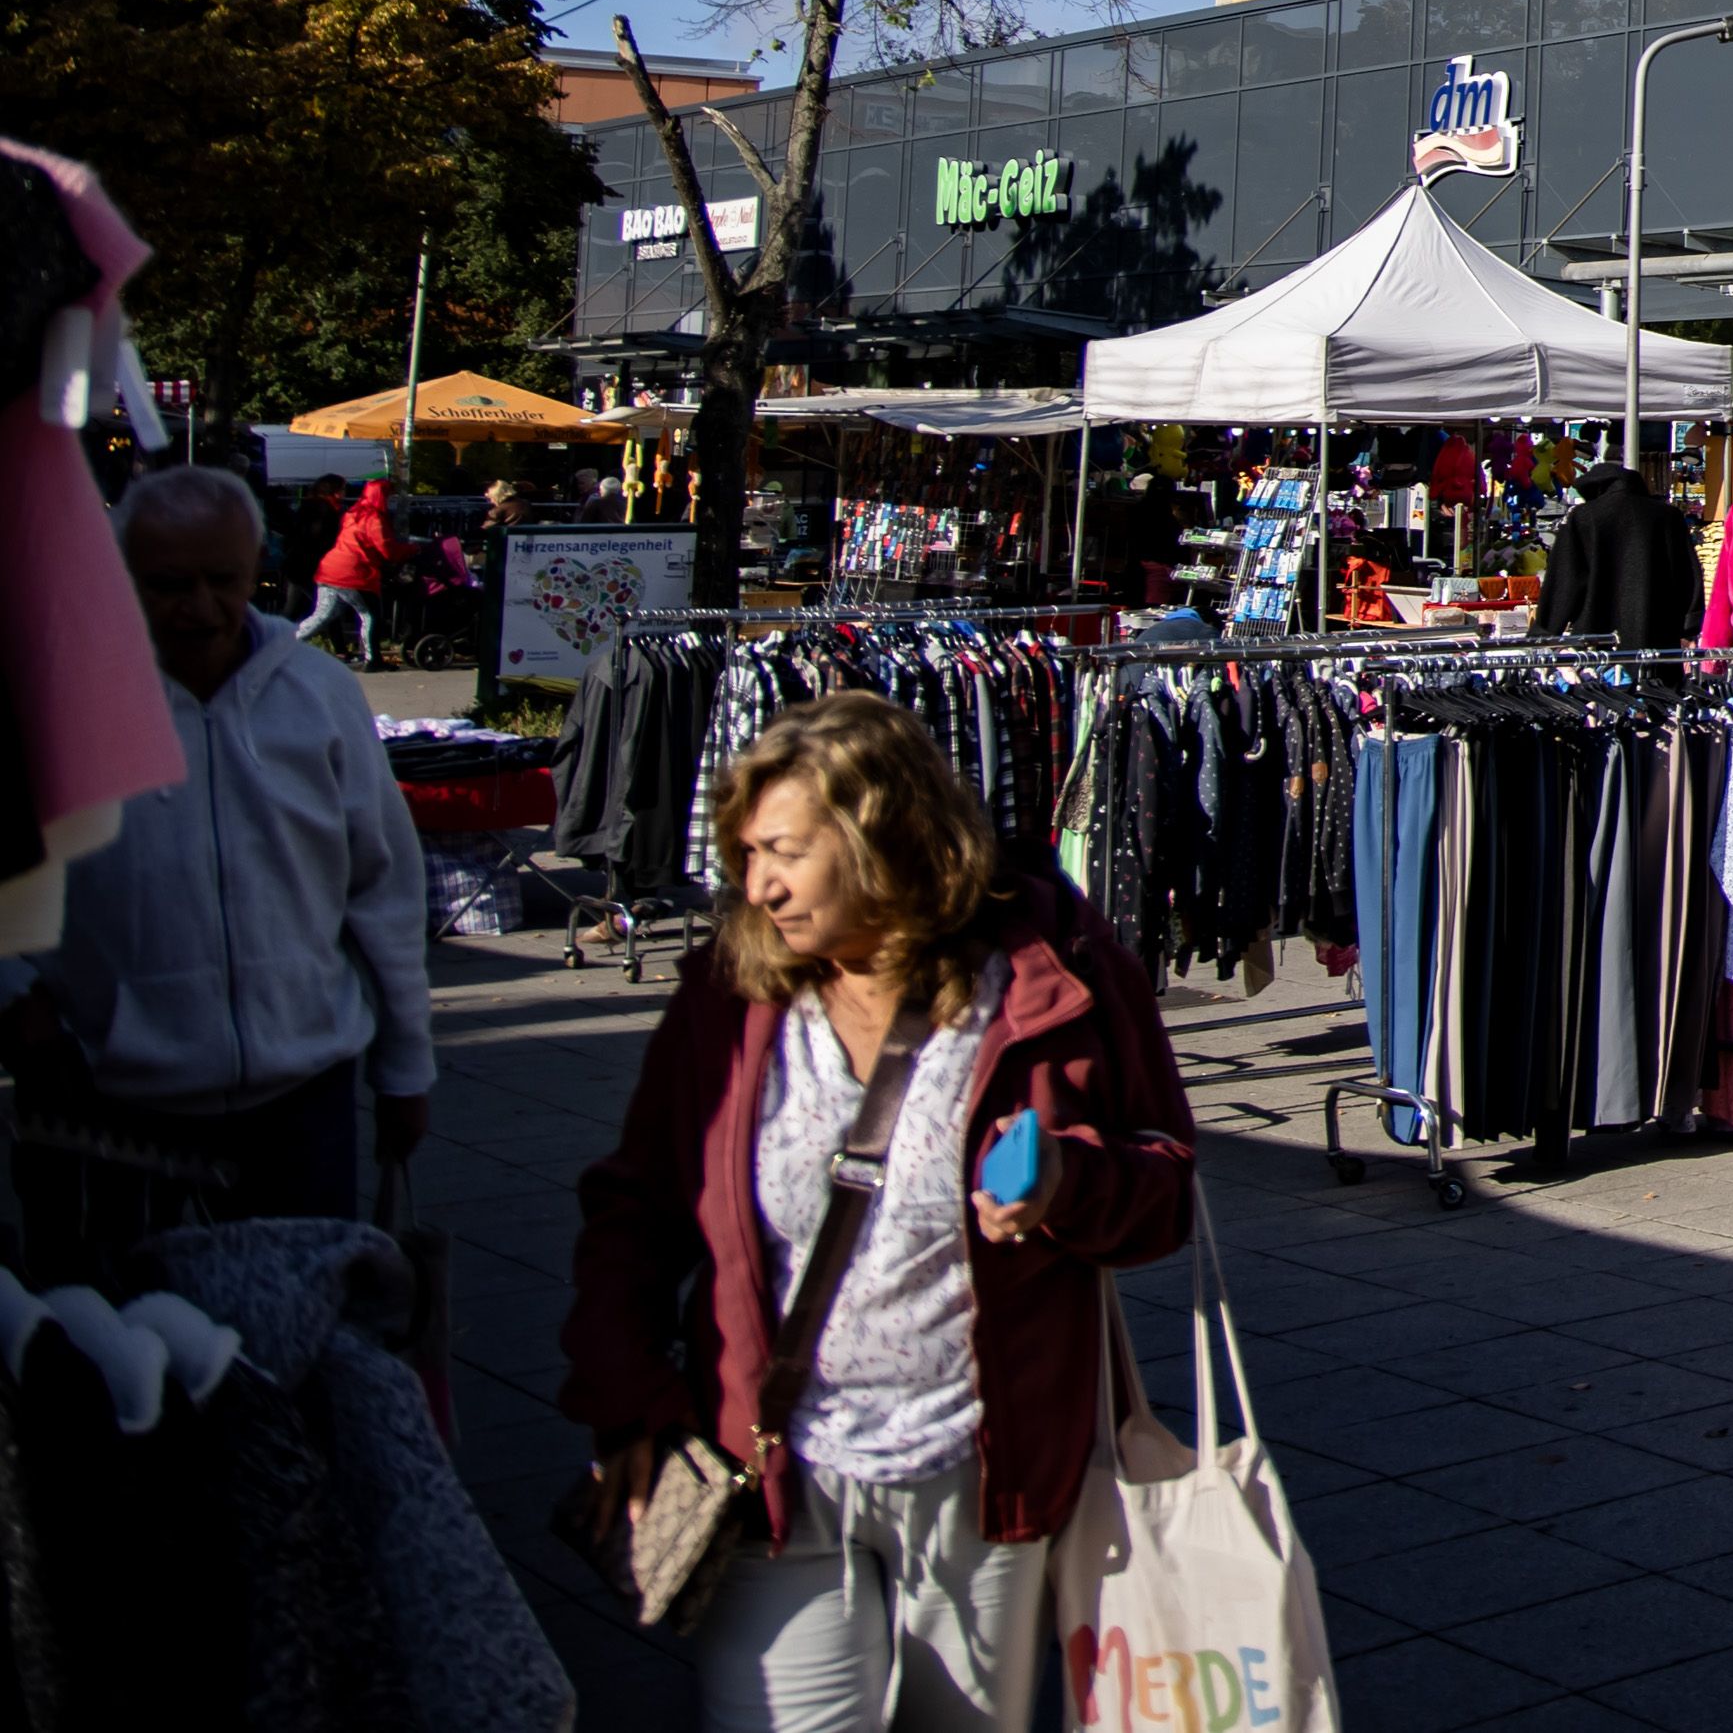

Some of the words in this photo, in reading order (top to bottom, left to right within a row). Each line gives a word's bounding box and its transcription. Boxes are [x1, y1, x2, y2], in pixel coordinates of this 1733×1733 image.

[1429, 62, 1494, 133] dm
[935, 148, 1060, 225] Mäc-Geiz
[621, 209, 653, 243] BAO
[653, 204, 687, 238] BAO
[513, 539, 673, 555] Herzensangelegenheit
